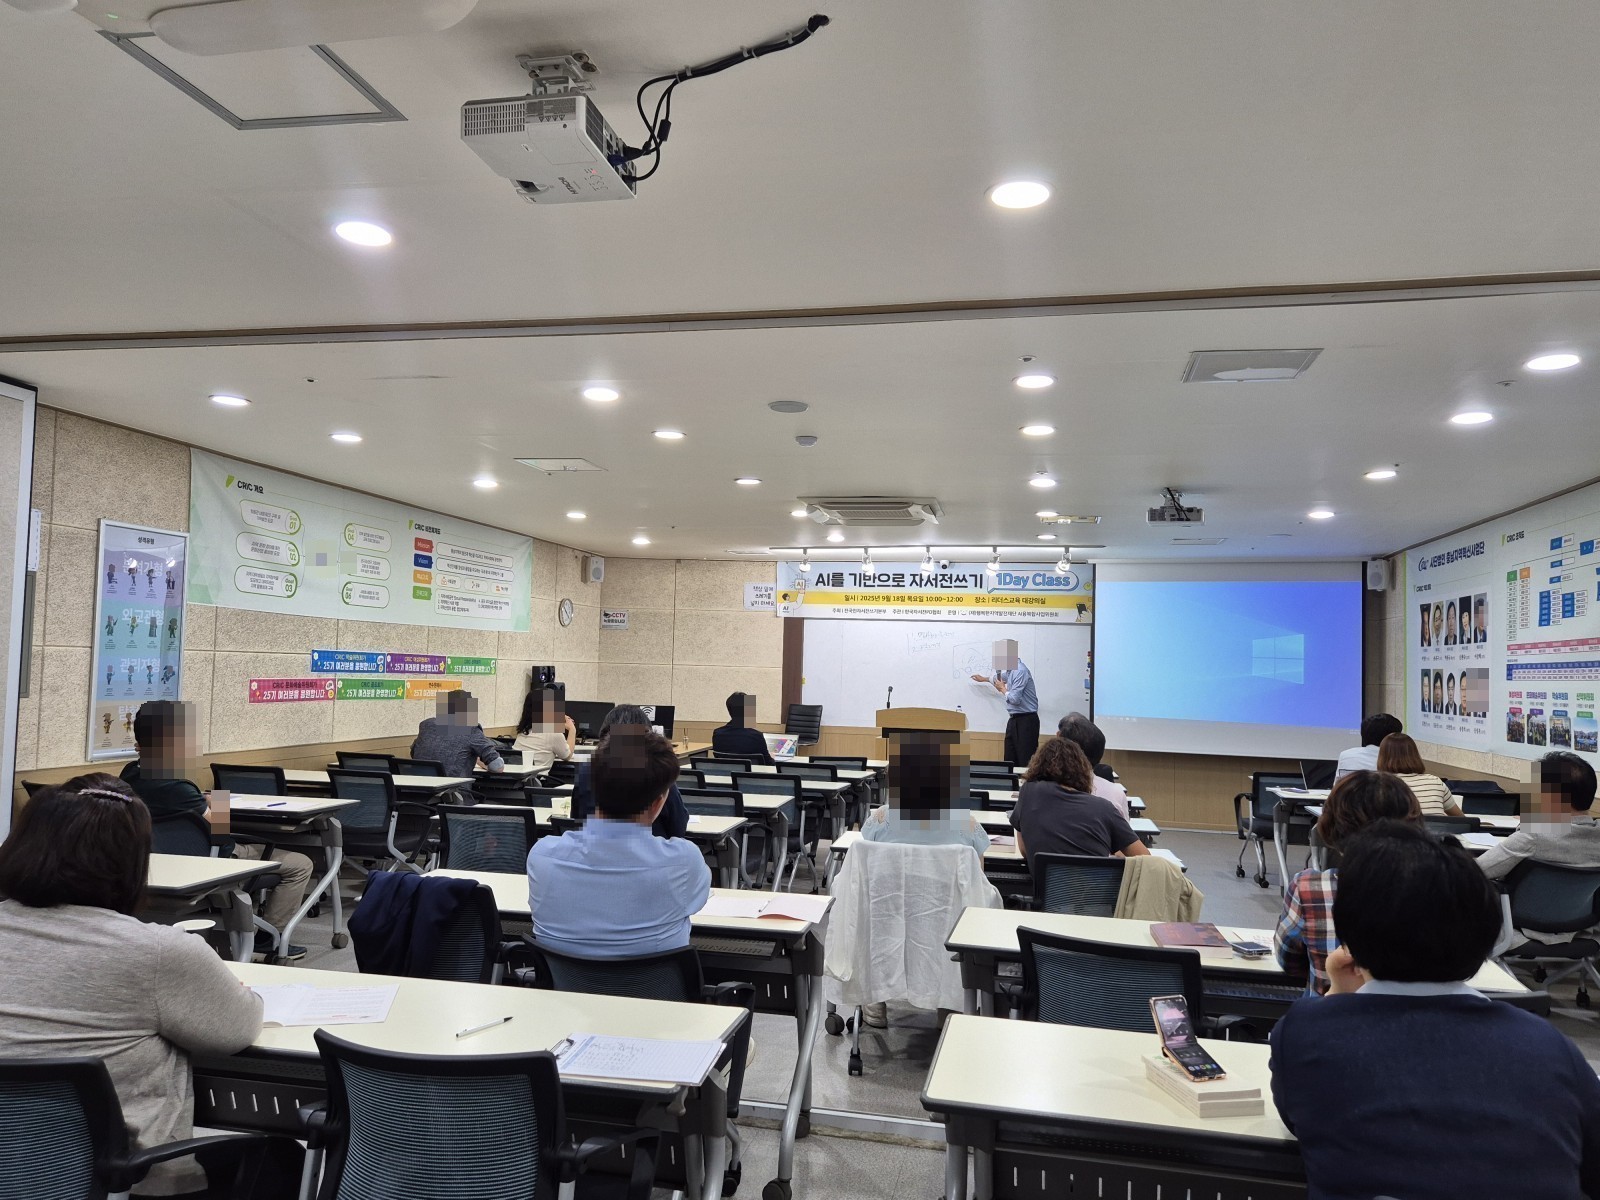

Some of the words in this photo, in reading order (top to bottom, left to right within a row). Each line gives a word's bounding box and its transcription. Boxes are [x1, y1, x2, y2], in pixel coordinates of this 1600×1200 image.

[1429, 553, 1445, 568] 사단법인
[815, 573, 844, 587] AI를
[849, 573, 906, 588] 기반으로
[909, 573, 983, 589] 자서전쓰기
[996, 573, 1029, 589] 1Day
[1032, 573, 1071, 587] Class
[121, 608, 165, 626] 외교관형
[120, 658, 160, 673] 관리자형
[323, 662, 334, 670] 25기
[336, 662, 354, 671] 여러분을
[263, 691, 276, 700] 25기
[277, 690, 299, 700] 여러분을
[300, 689, 325, 699] 응원합니다
[346, 689, 357, 698] 25기
